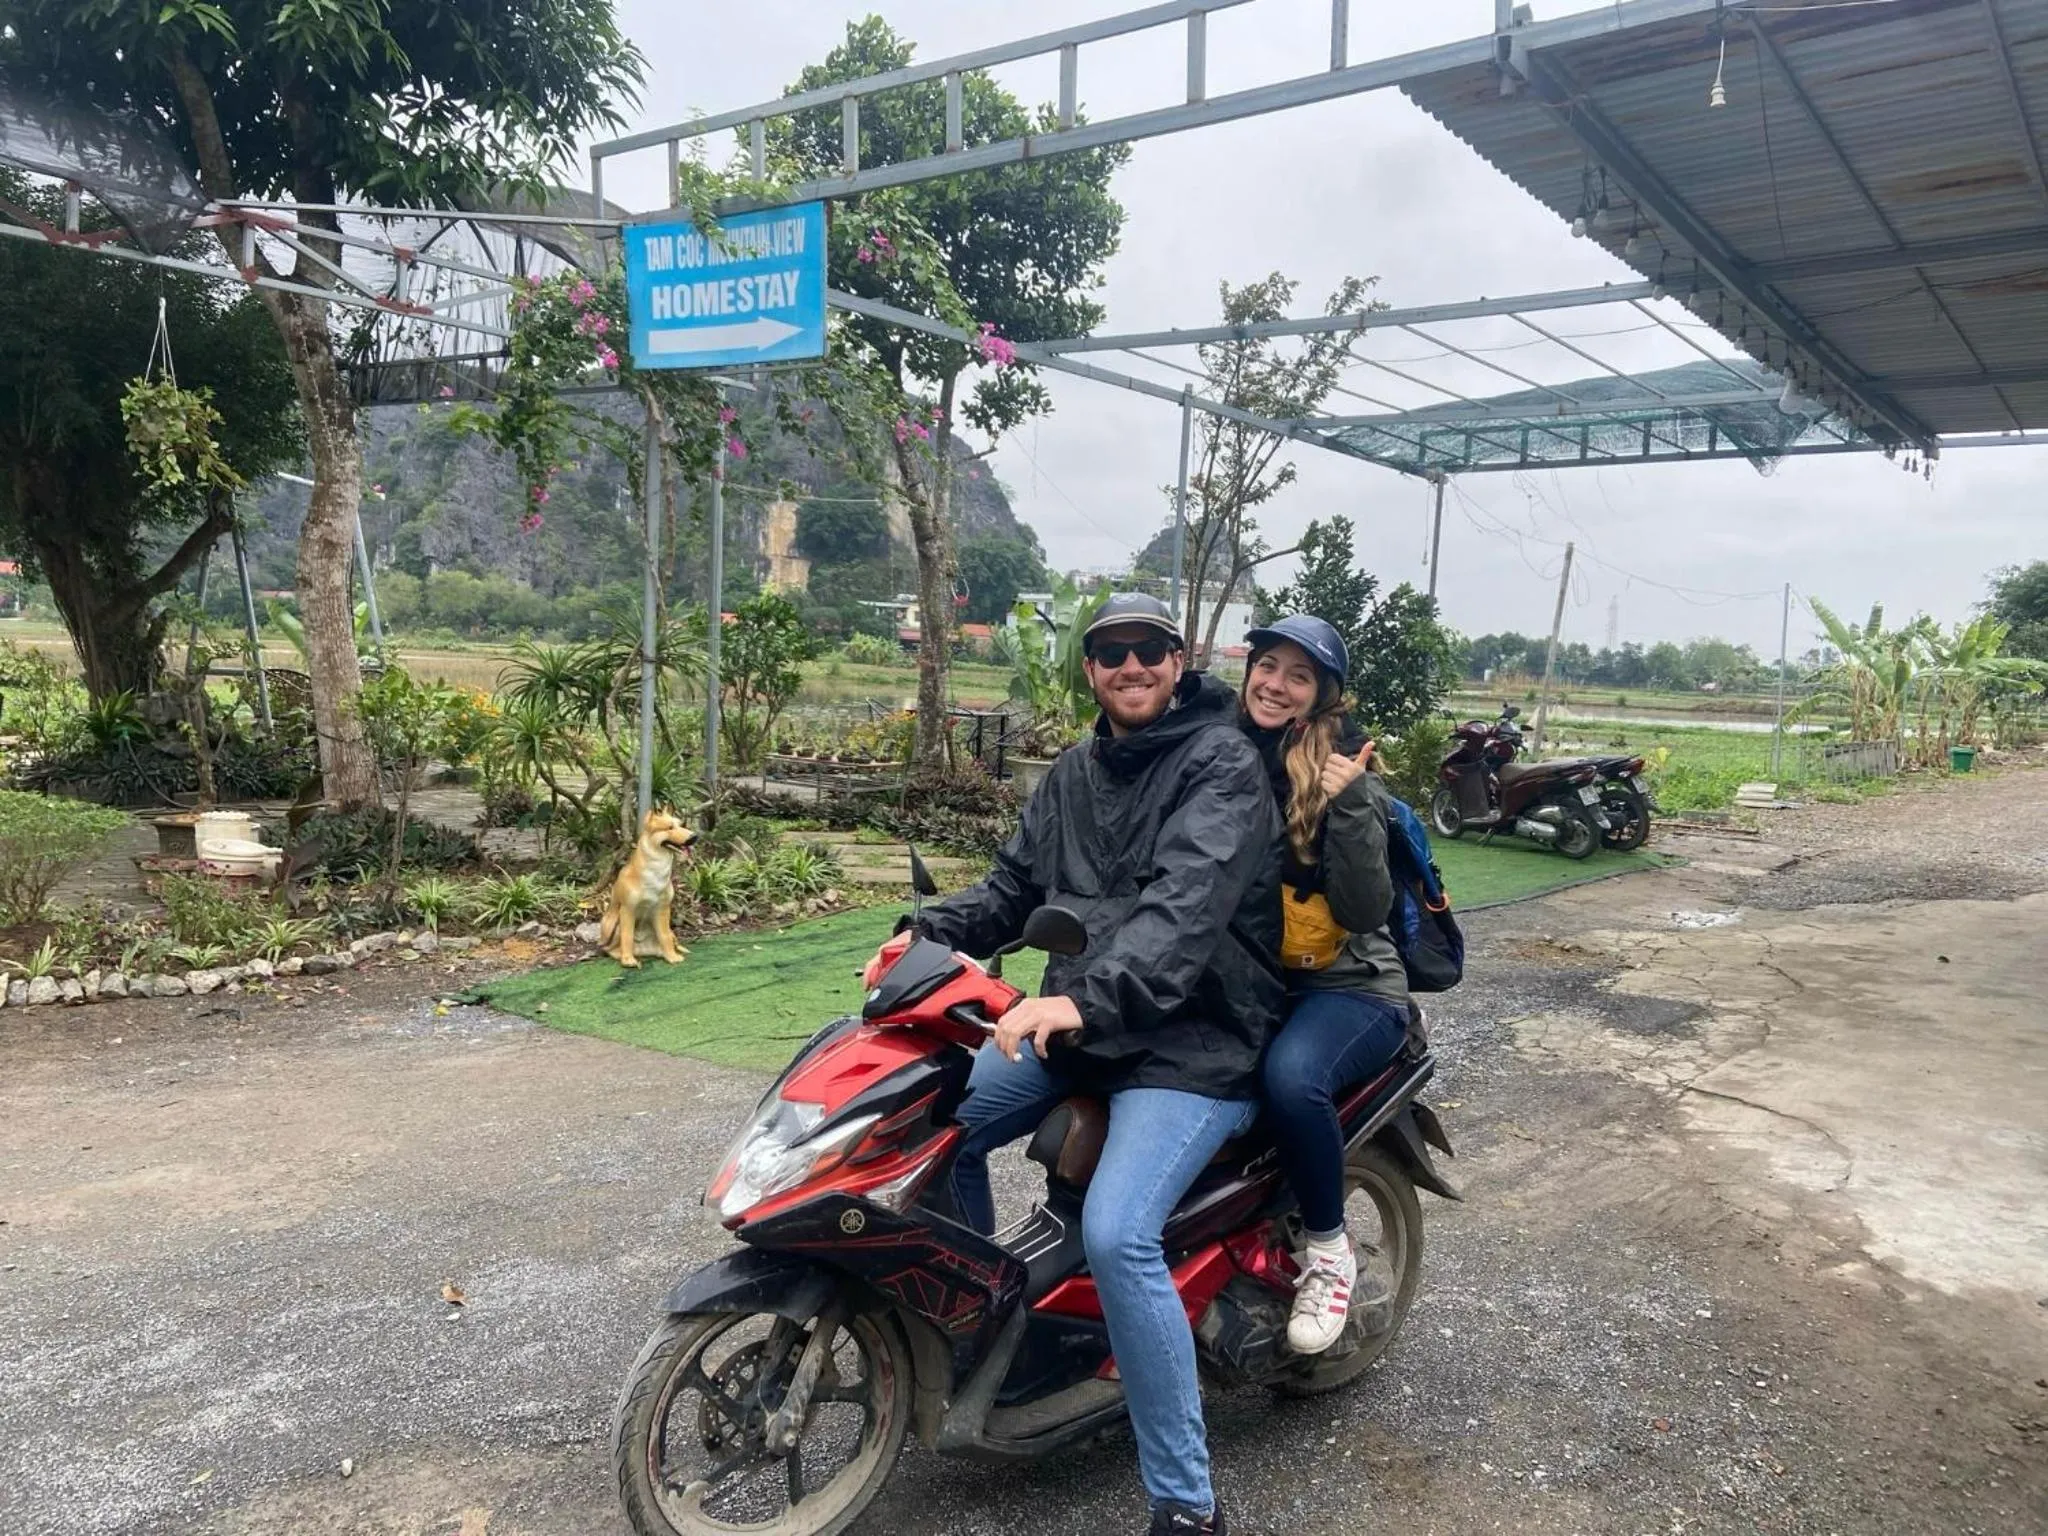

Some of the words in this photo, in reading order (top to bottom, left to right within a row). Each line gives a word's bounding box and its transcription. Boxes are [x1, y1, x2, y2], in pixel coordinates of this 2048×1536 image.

[644, 235, 673, 271] TAM
[677, 233, 703, 268] COC
[773, 217, 805, 256] VIEW
[652, 270, 800, 320] HOMESTAY
